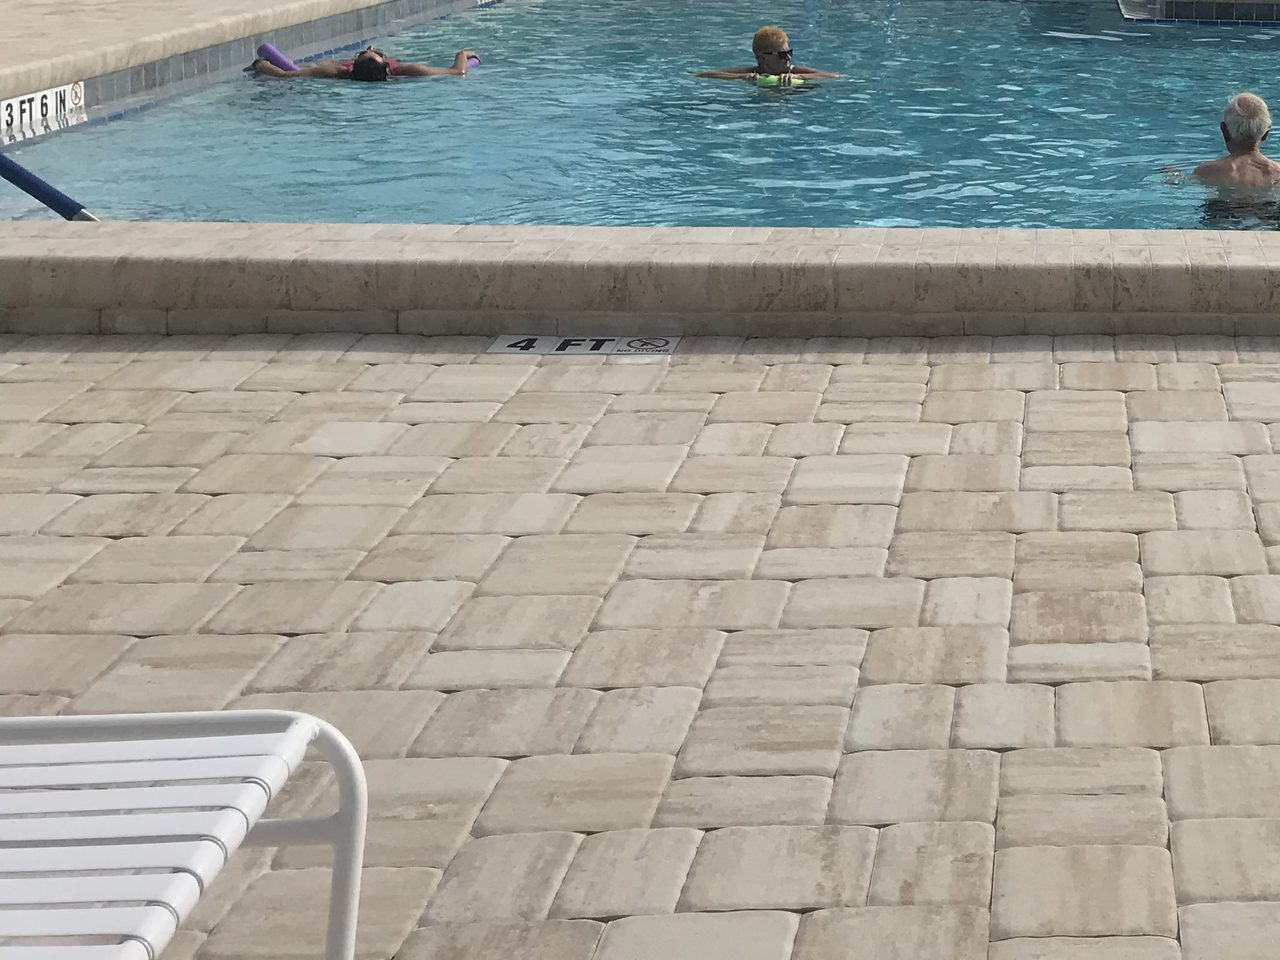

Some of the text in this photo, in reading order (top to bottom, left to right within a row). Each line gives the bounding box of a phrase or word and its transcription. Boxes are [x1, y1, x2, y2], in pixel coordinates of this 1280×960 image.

[5, 102, 14, 128] 3
[19, 96, 35, 125] FT
[40, 93, 48, 118] 6
[55, 88, 66, 116] IN
[506, 337, 616, 352] 4 FT
